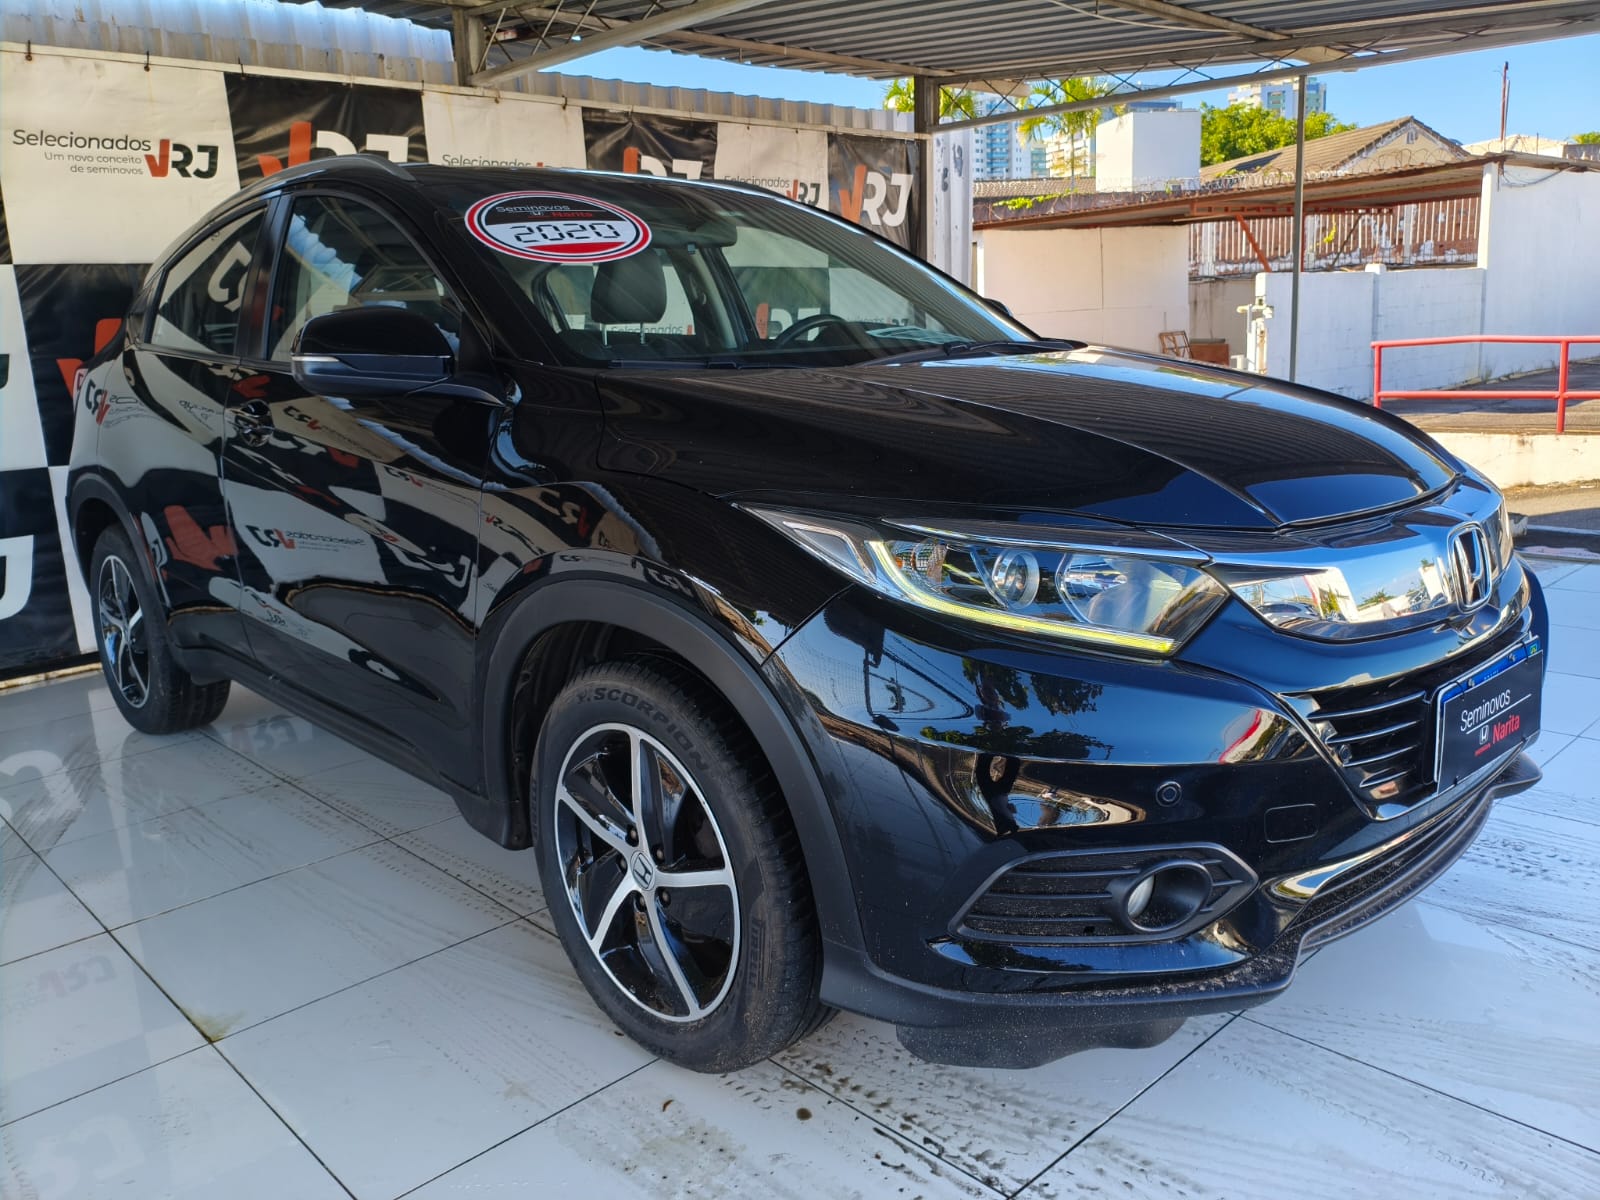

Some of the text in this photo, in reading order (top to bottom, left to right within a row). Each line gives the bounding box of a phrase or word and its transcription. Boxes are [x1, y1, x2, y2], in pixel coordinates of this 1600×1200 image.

[12, 129, 152, 151] Selecionados
[44, 152, 143, 165] Um novo conceito
[144, 138, 219, 179] VRJ
[70, 164, 144, 176] de seminovos
[510, 222, 622, 243] 2020
[1460, 689, 1511, 732] Seminovos
[1492, 714, 1521, 744] Narita
